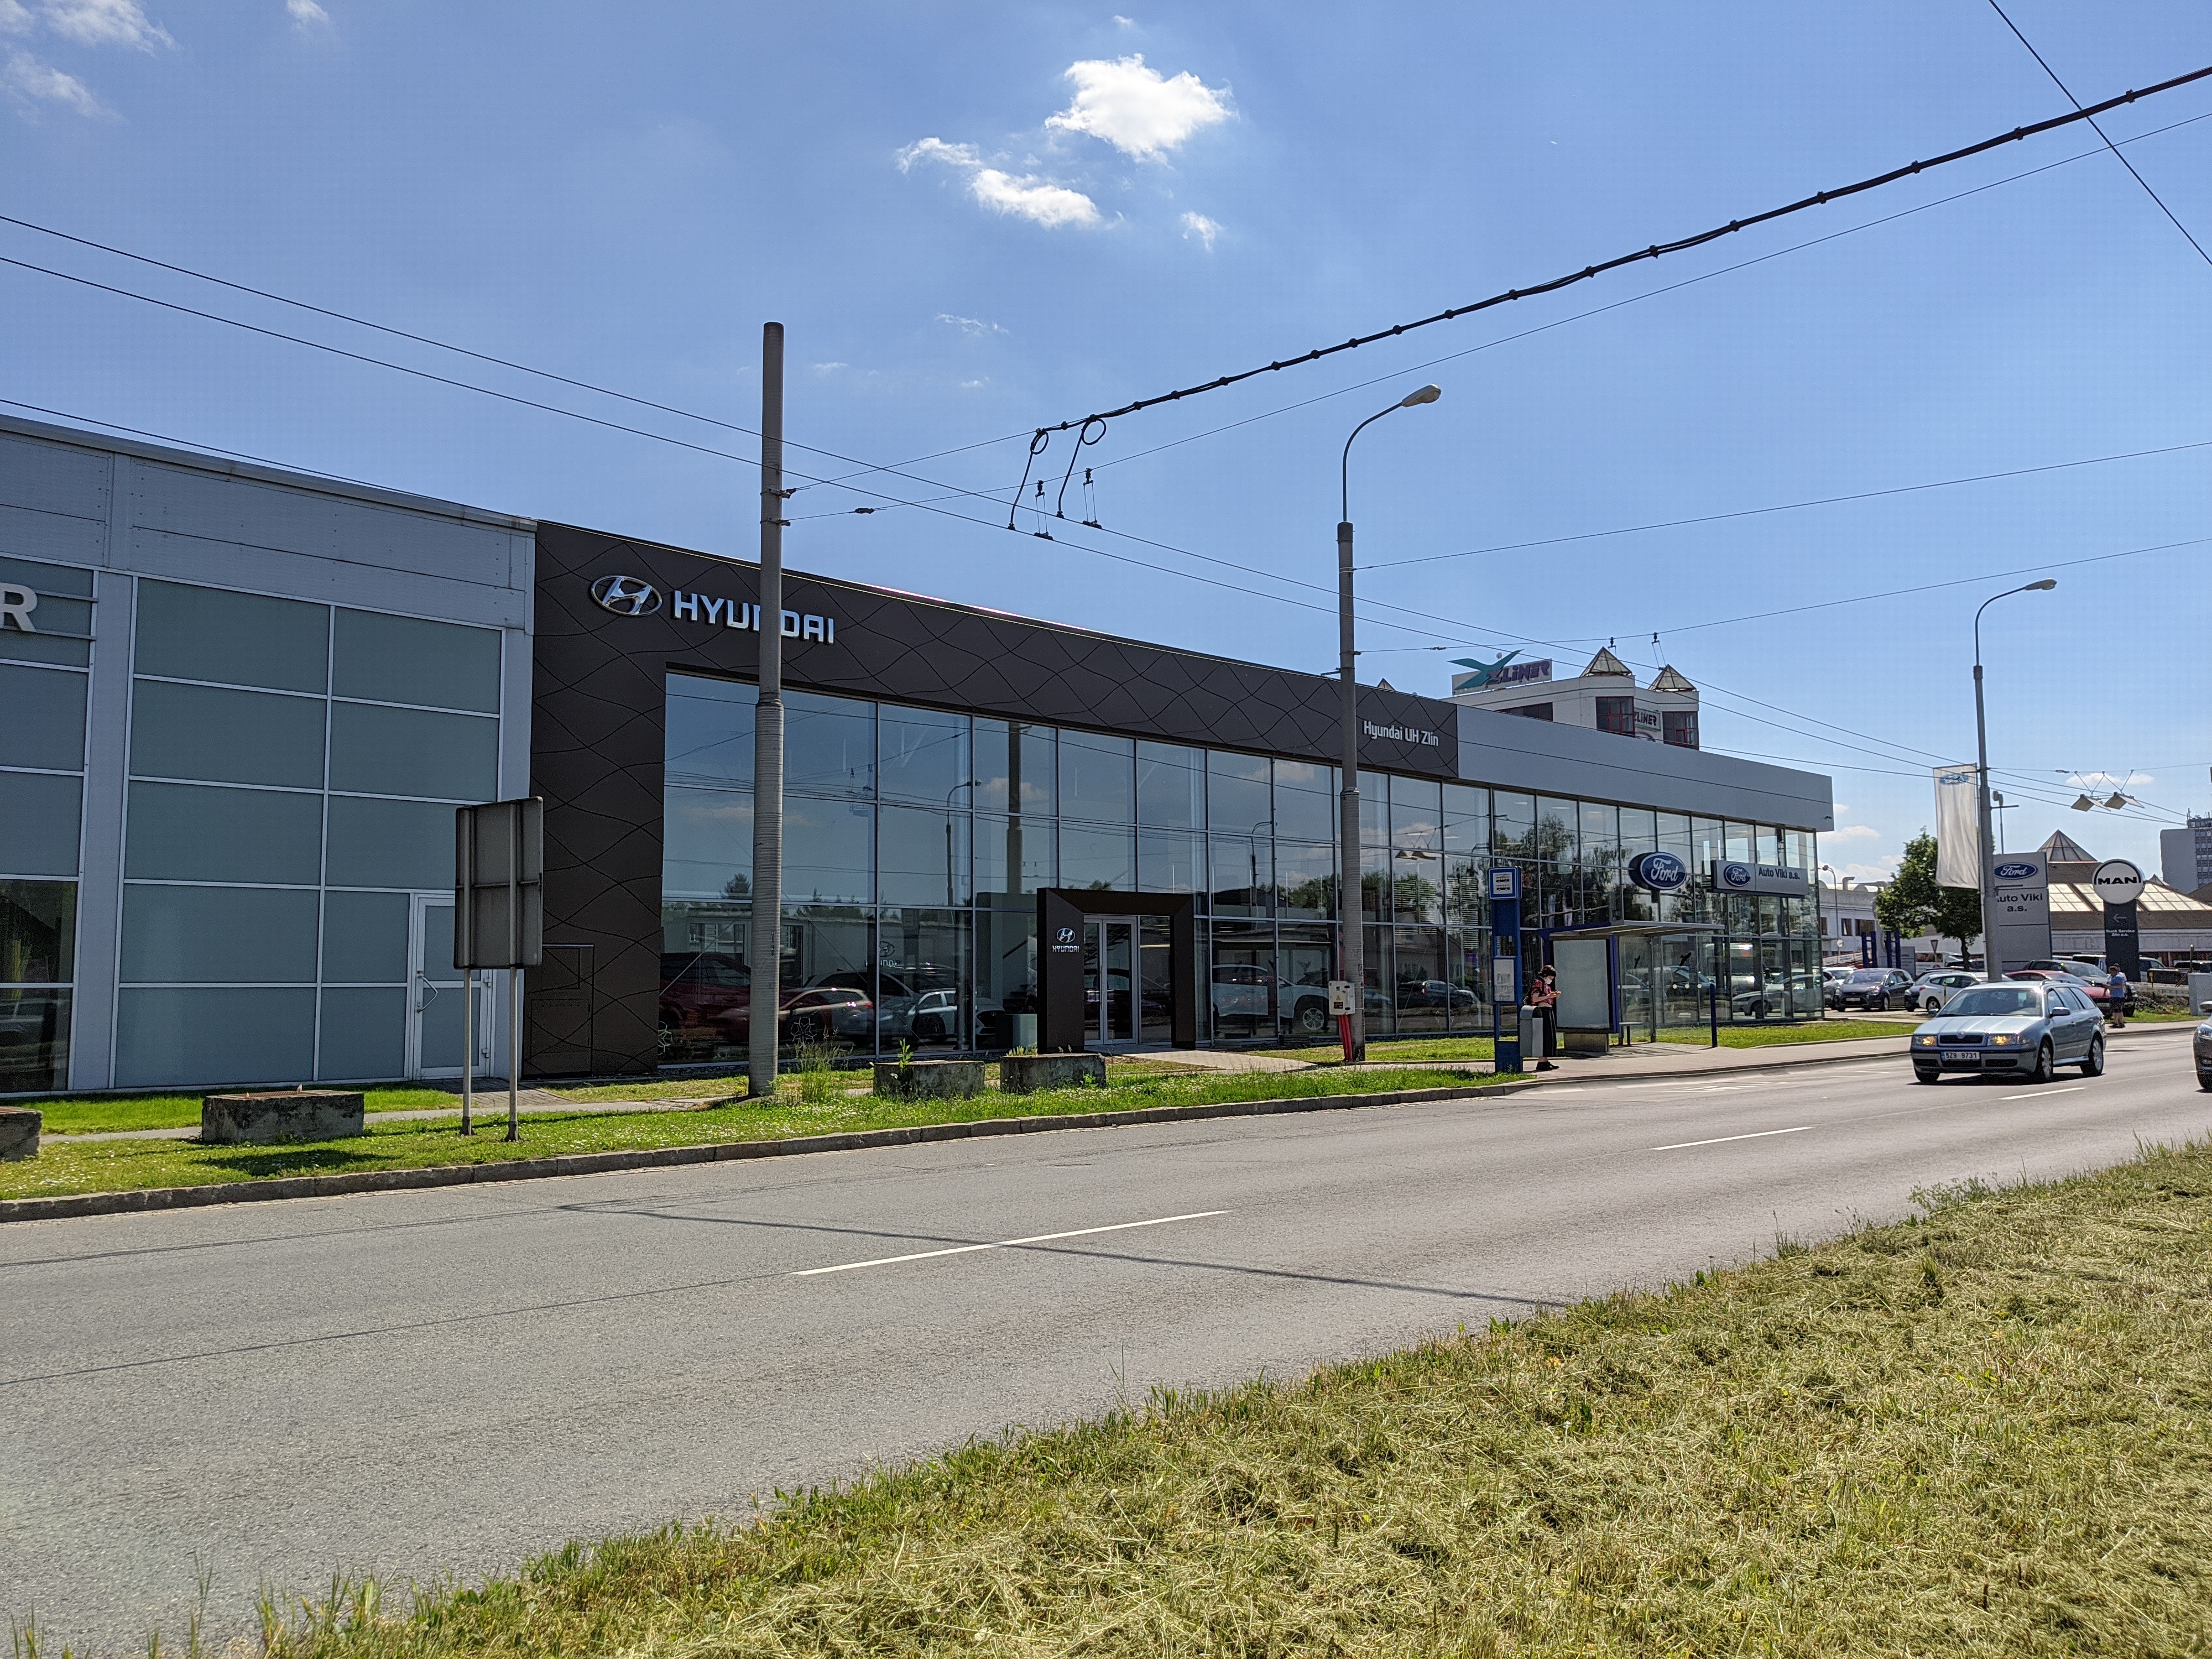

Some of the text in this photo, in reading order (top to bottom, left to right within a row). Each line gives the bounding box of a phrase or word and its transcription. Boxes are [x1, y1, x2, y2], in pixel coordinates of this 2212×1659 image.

[1363, 721, 1403, 740] Hyundai
[1405, 727, 1419, 743] UH
[1650, 857, 1679, 882] Ford
[1731, 867, 1801, 881] Ford Auto Viki a.s.
[2000, 865, 2028, 876] Ford
[2098, 877, 2137, 885] MAN
[2021, 893, 2043, 901] Viki
